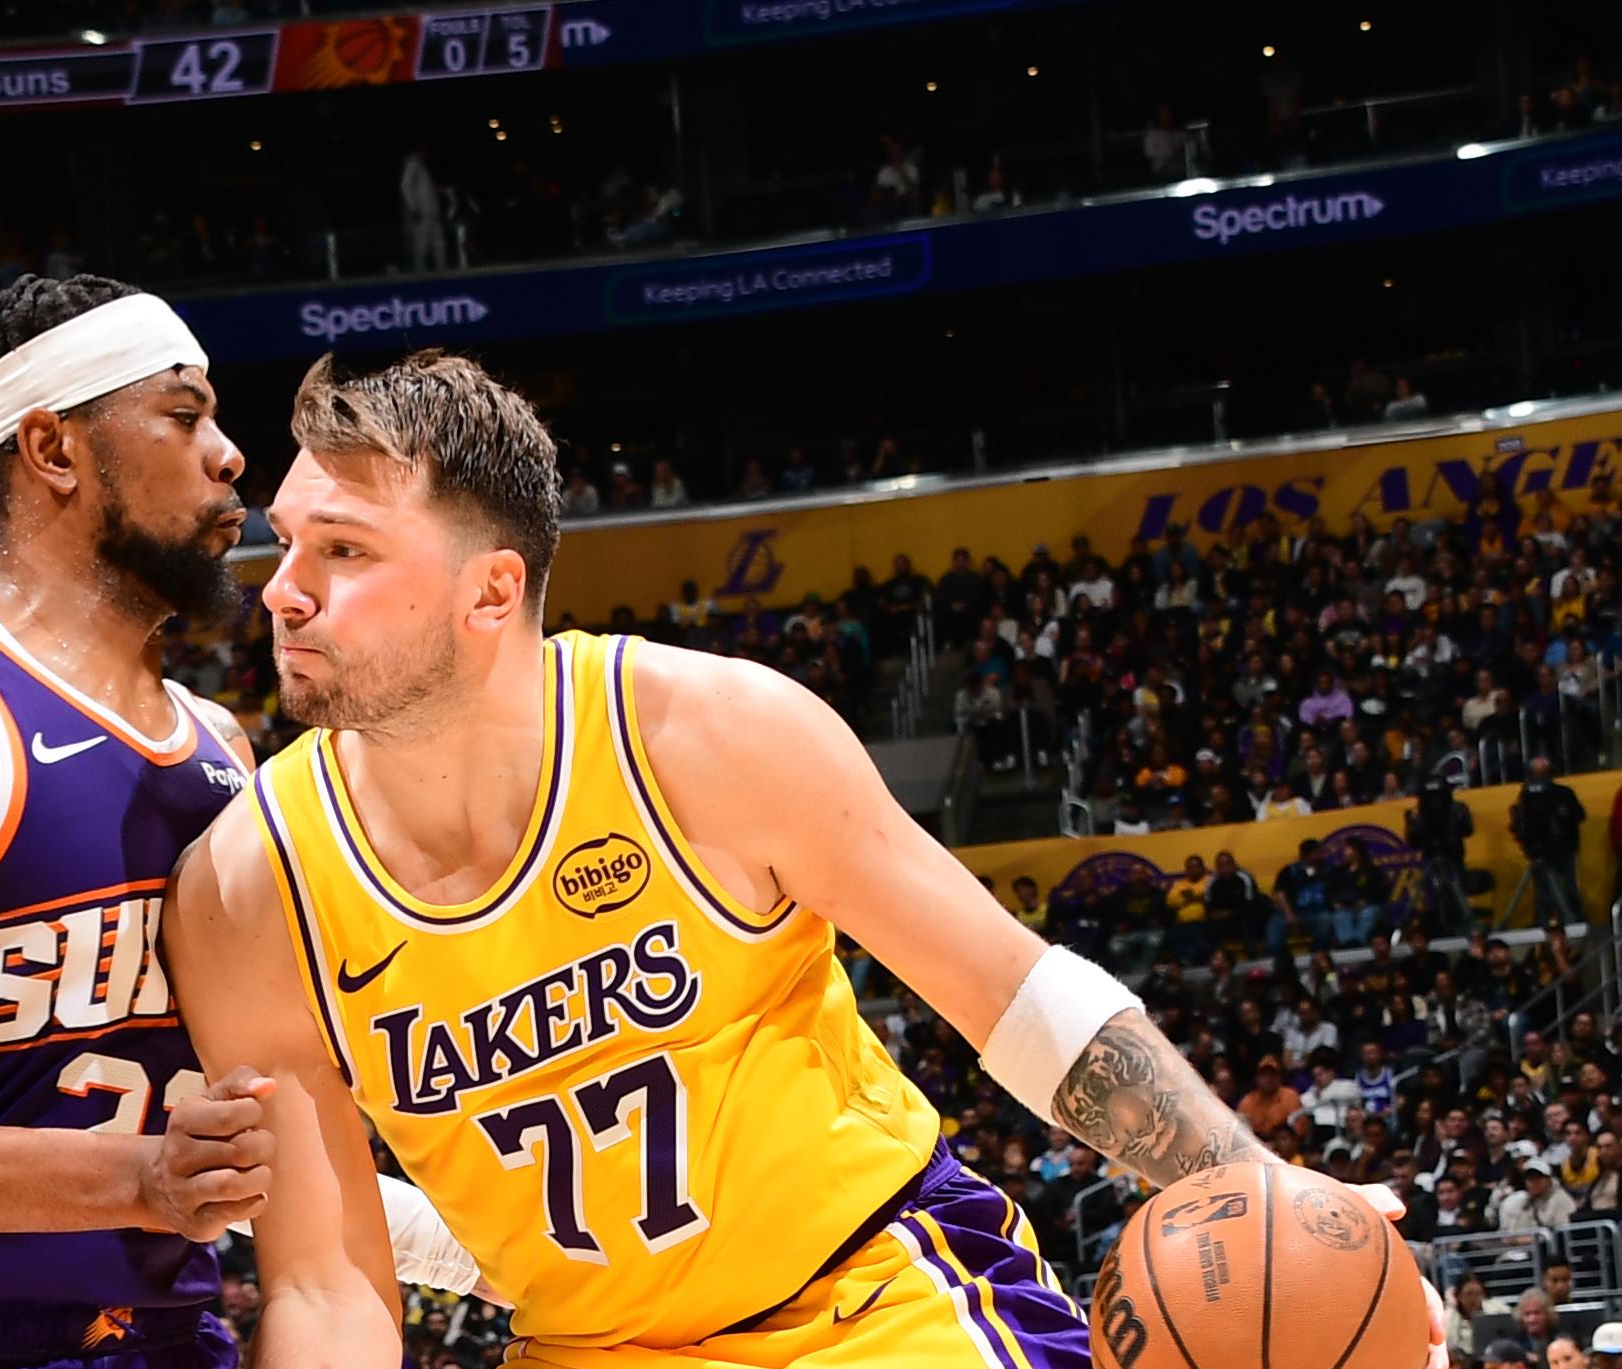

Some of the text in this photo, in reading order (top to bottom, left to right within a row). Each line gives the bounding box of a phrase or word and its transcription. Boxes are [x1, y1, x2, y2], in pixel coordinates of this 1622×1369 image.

[171, 41, 245, 94] 42
[443, 38, 466, 72] 0
[508, 34, 530, 68] 5
[1192, 192, 1381, 246] Spectrum
[643, 255, 892, 305] Keeping LA Connected
[298, 296, 485, 340] Spectrum
[1135, 476, 1327, 542] LOS
[560, 849, 643, 898] bibigo
[582, 881, 618, 904] 비비고
[370, 920, 703, 1115] LAKERS
[472, 1050, 712, 1267] 77
